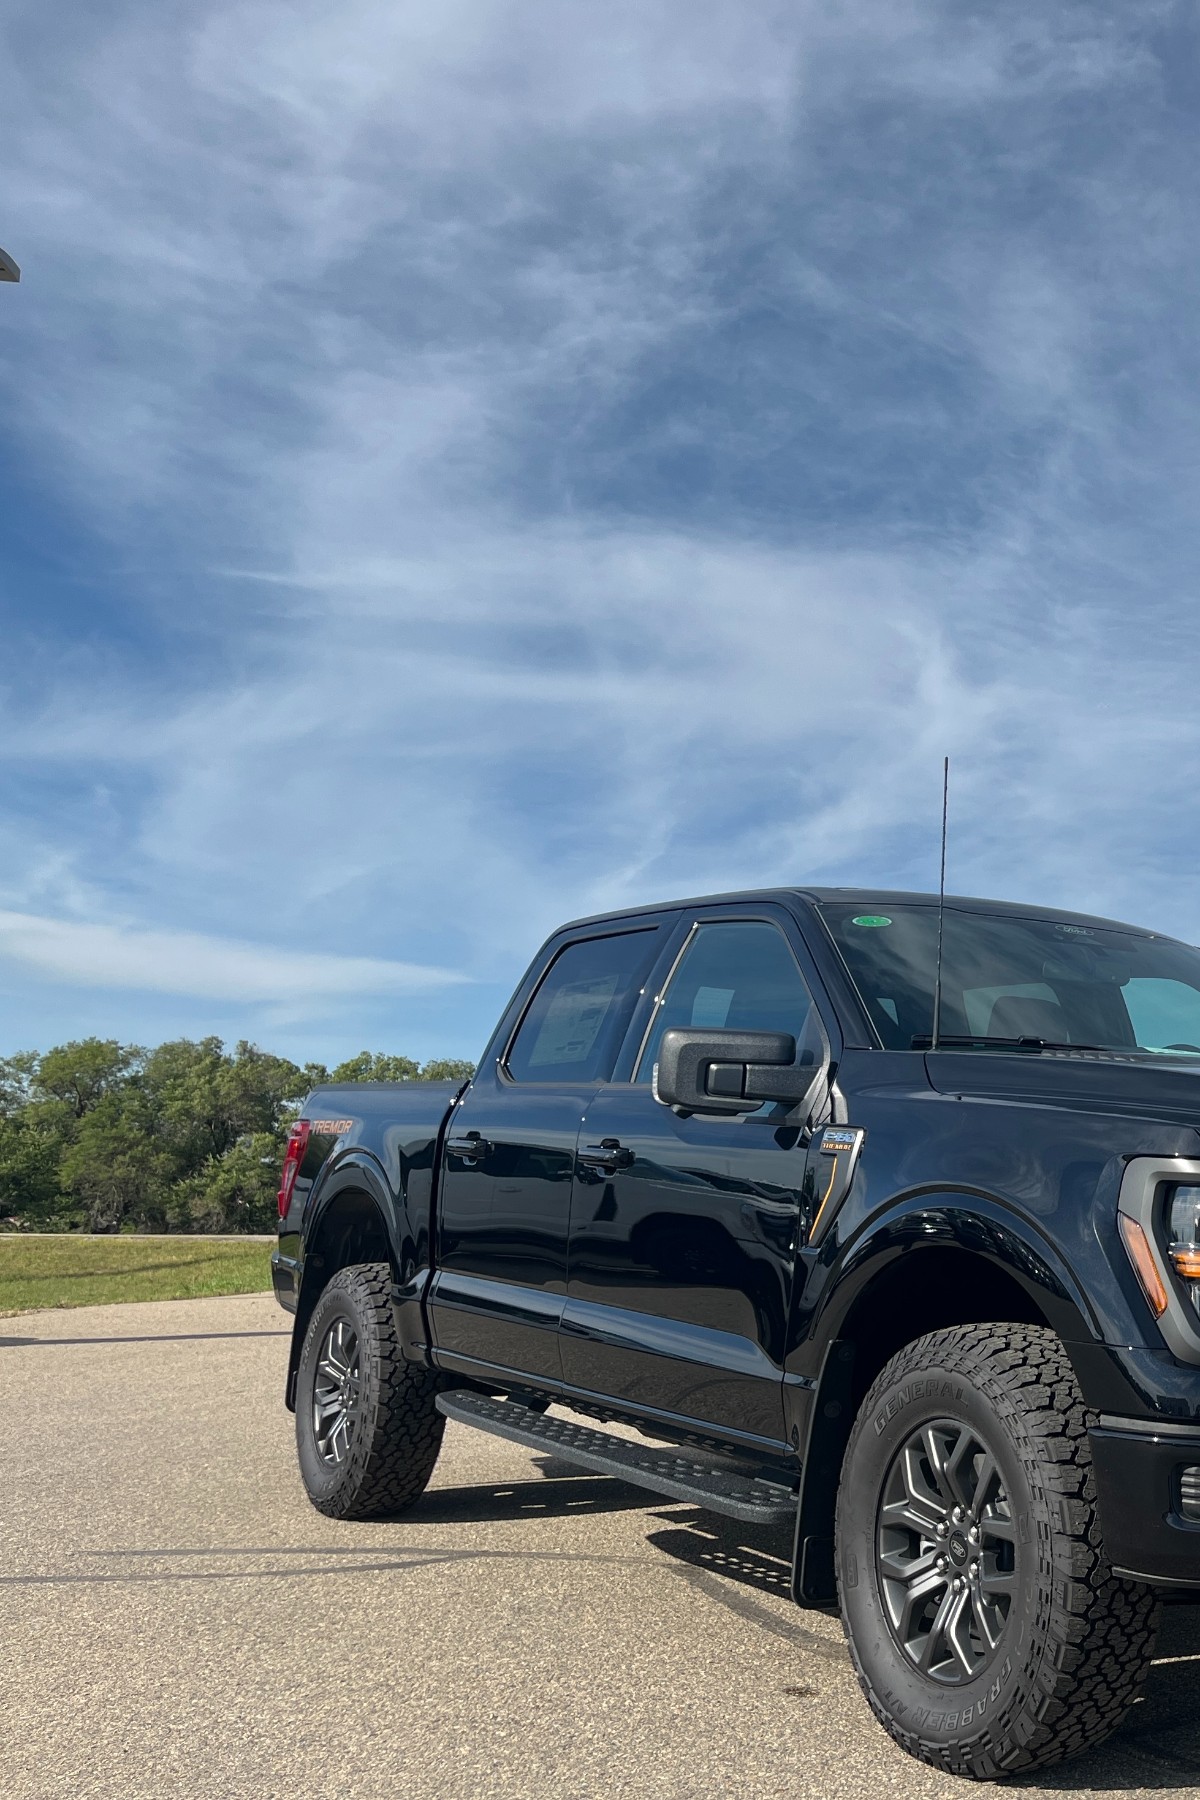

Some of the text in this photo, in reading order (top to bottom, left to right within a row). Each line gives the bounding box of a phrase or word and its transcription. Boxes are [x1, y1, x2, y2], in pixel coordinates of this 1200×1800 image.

[311, 1119, 354, 1135] TREMOR
[873, 1379, 969, 1437] GENERAL
[912, 1655, 1012, 1731] GRABBER
